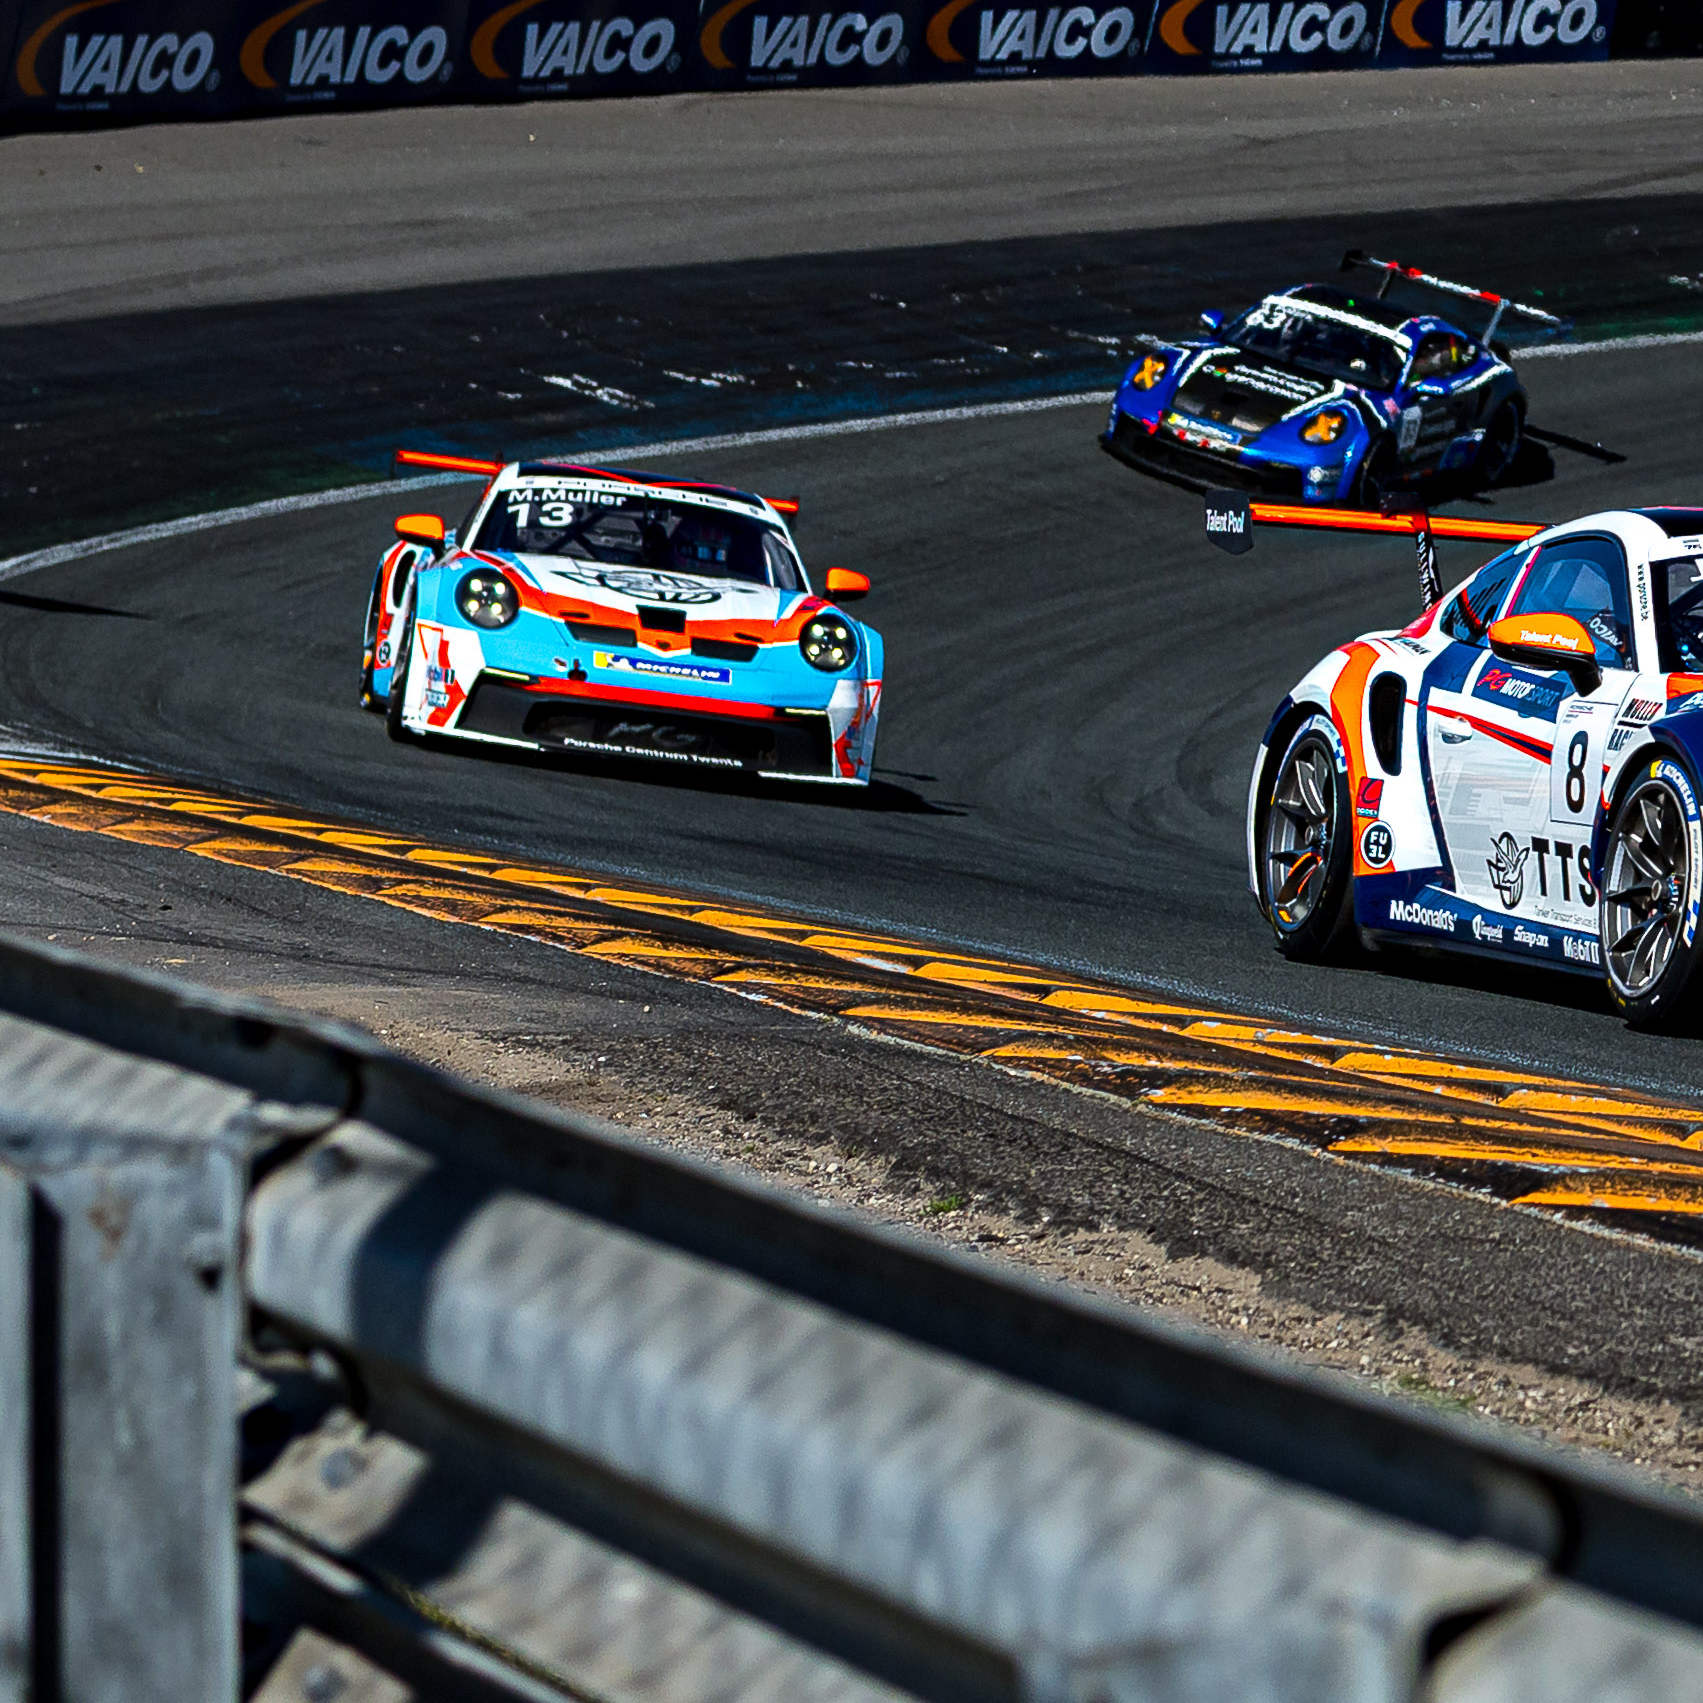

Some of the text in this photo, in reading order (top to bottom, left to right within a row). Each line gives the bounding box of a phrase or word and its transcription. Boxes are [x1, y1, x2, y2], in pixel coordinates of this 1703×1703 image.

[291, 26, 446, 84] VAICO
[522, 18, 674, 76] VAICO
[751, 13, 903, 67] VAICO
[979, 6, 1134, 60] VAICO
[1214, 2, 1366, 54] VAICO
[61, 32, 213, 93] VAICO
[507, 502, 574, 528] 13
[1565, 731, 1589, 815] 8
[1531, 836, 1598, 907] TTS
